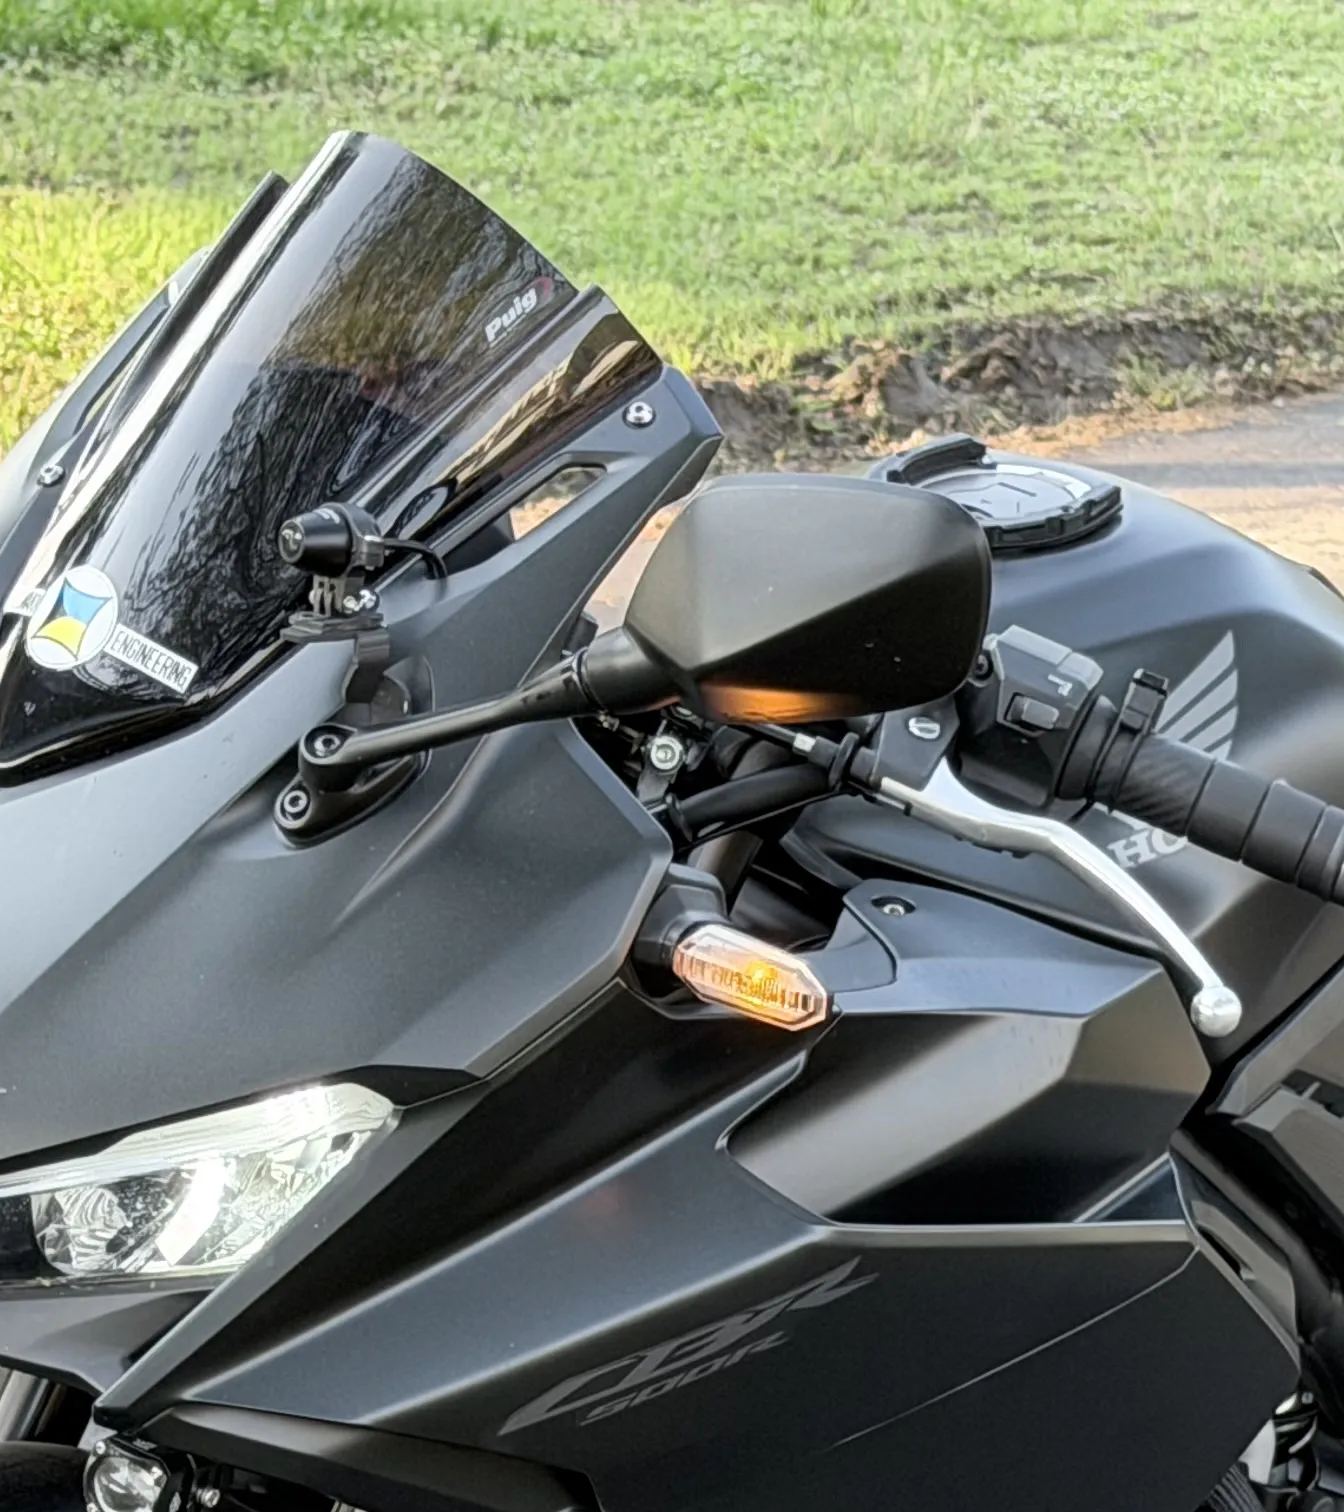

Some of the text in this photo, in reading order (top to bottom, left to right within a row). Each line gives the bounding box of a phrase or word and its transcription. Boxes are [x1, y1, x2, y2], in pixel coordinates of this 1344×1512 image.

[485, 287, 537, 342] Puig
[110, 630, 194, 689] ENGINEERING
[497, 1255, 880, 1436] CBR
[579, 1331, 789, 1426] 500R
